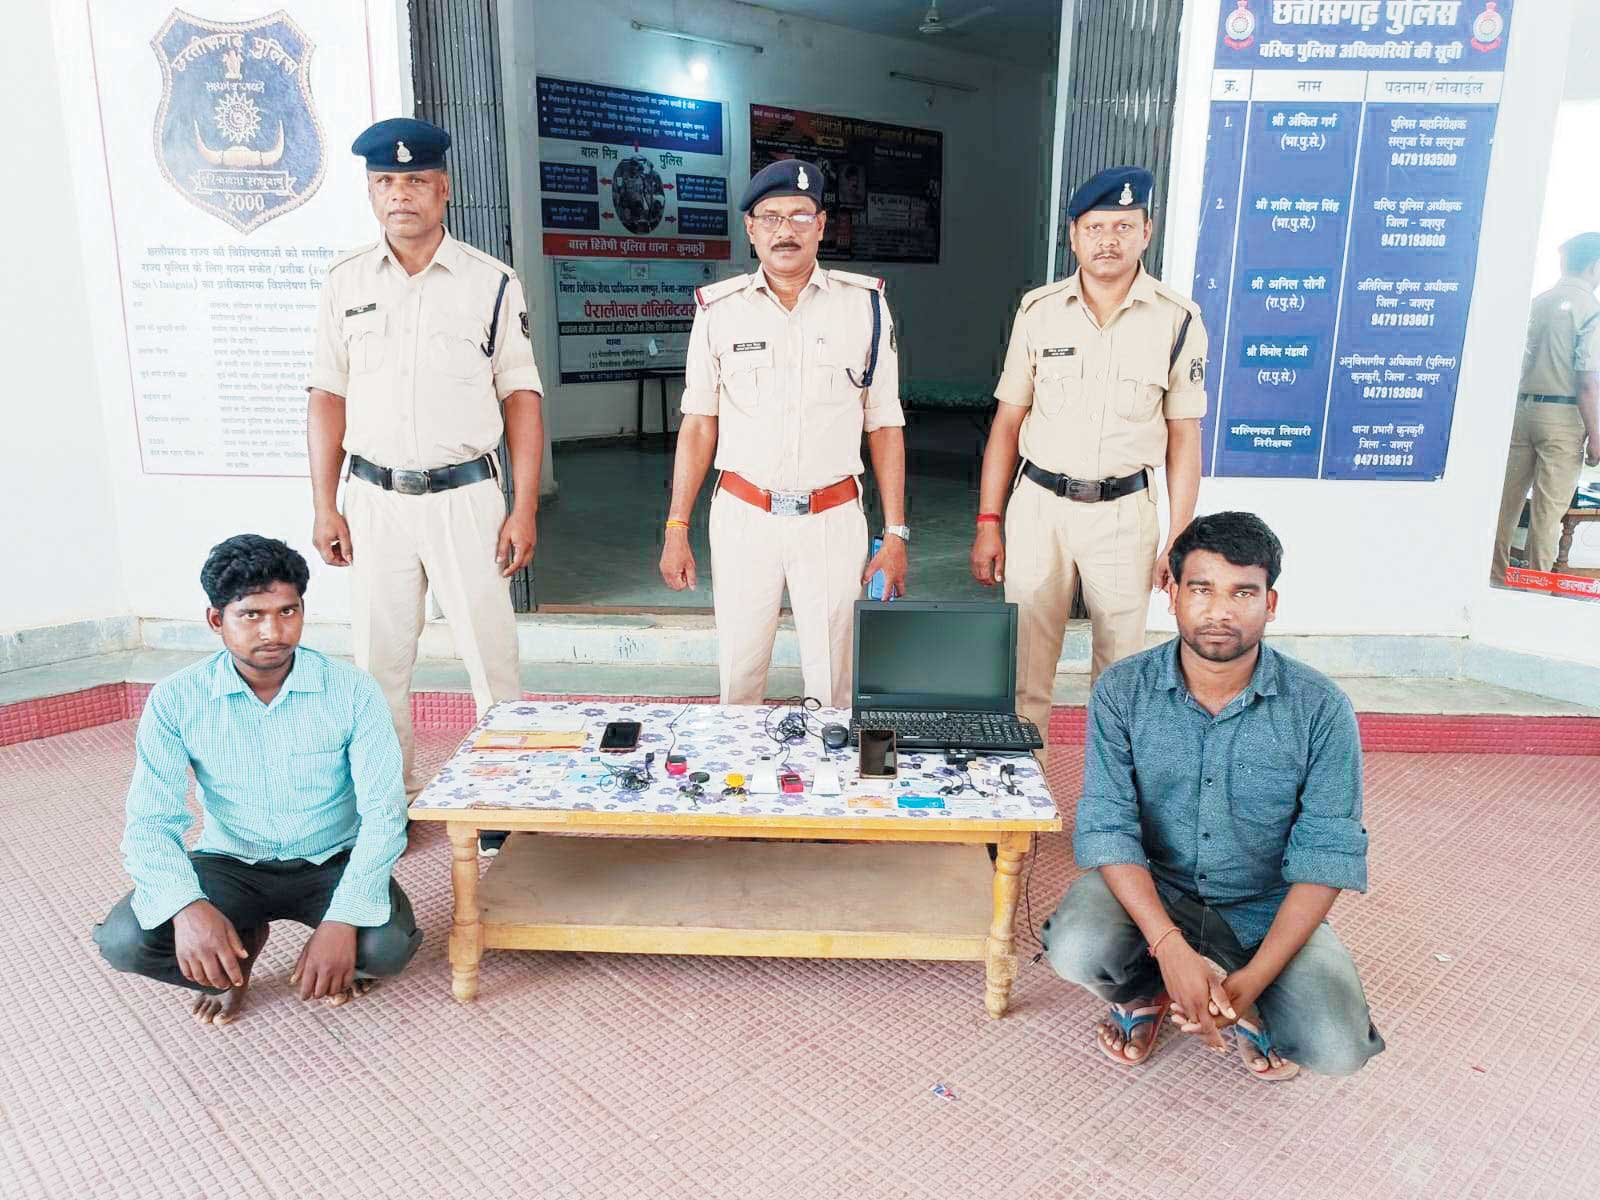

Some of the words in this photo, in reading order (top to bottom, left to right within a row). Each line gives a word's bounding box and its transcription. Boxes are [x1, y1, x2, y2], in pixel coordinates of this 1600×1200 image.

[1297, 40, 1337, 62] पुलिस
[1414, 41, 1432, 59] की
[1435, 41, 1463, 64] सूची
[1297, 81, 1322, 93] नाम
[1271, 113, 1285, 127] श्री
[1391, 115, 1417, 132] पुलिस
[659, 152, 683, 169] पुलिस
[1399, 197, 1424, 214] पुलिस
[1386, 214, 1408, 227] जिला
[1251, 277, 1264, 290] श्री
[1268, 277, 1298, 290] अनिल
[1303, 276, 1326, 290] सोनी
[1396, 279, 1420, 294] पुलिस
[1376, 294, 1398, 308] जिला
[1426, 355, 1456, 369] (पुलिस)
[1384, 370, 1405, 382] जिला
[1359, 437, 1379, 449] जिला
